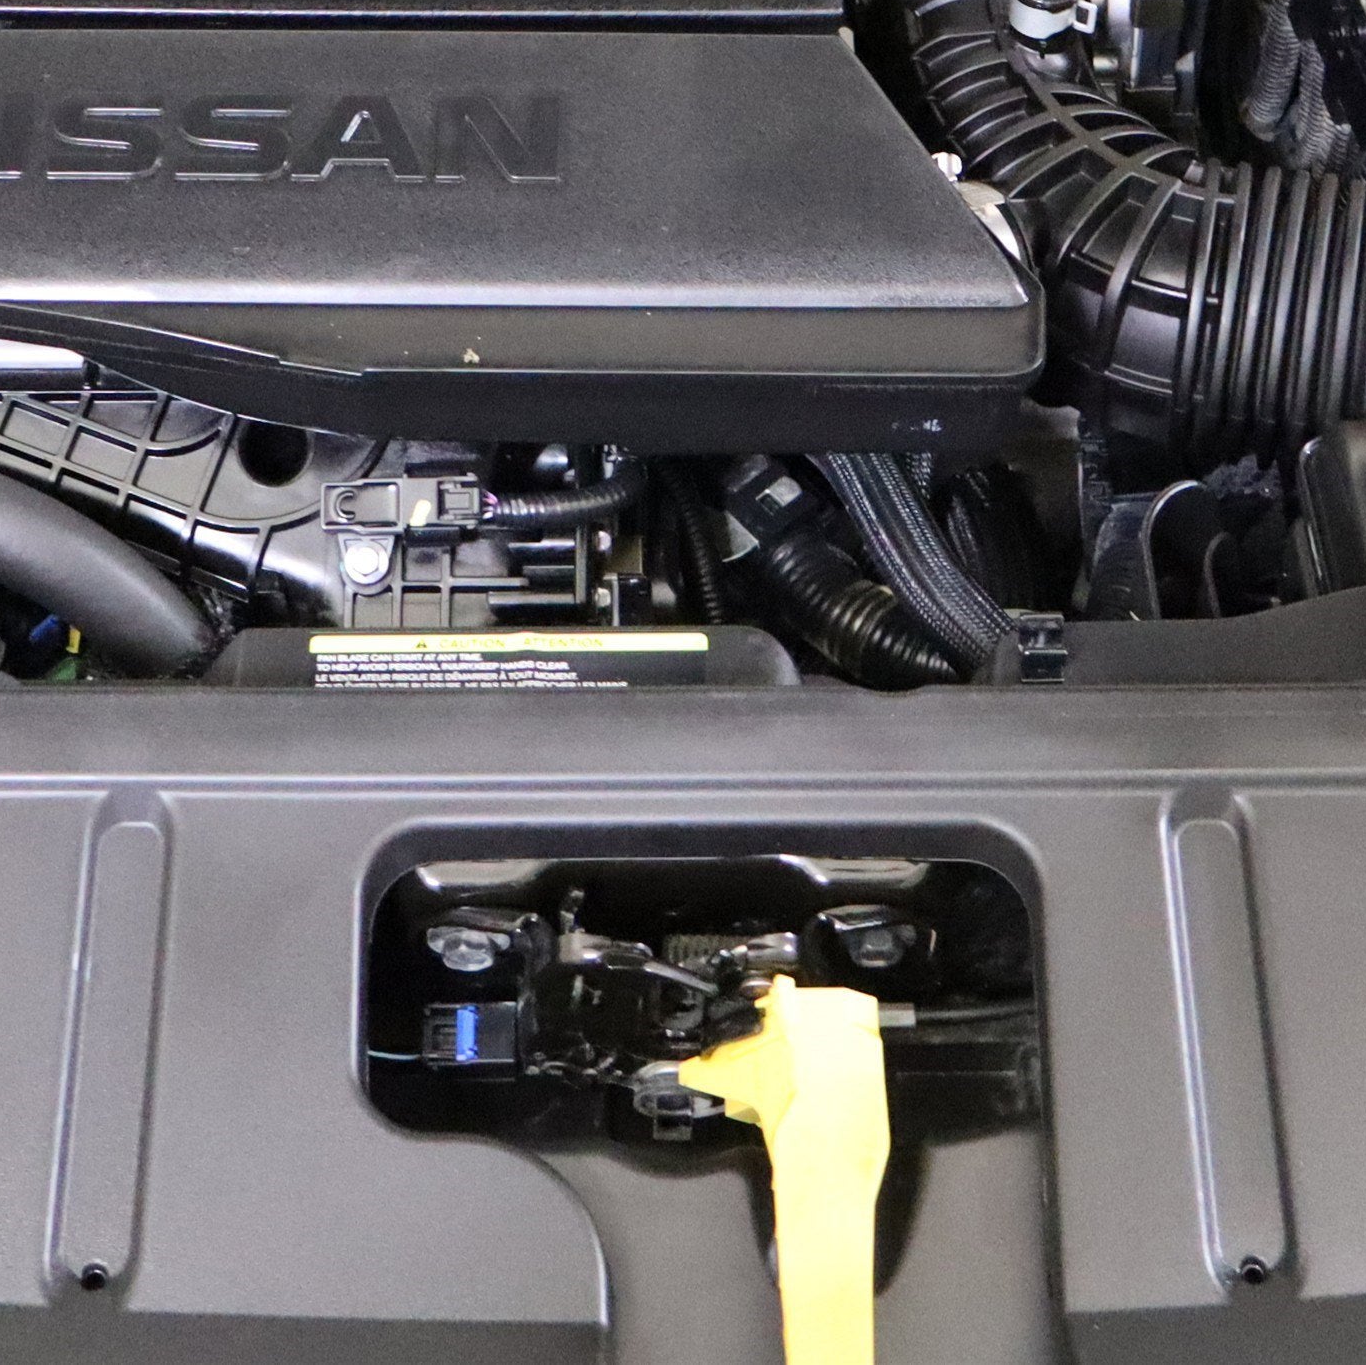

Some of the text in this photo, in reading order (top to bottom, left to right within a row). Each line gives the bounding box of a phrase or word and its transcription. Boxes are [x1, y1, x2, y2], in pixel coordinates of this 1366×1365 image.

[439, 637, 603, 649] CAUTION ATTENTION
[317, 653, 337, 662] FAN
[338, 653, 370, 662] BLADE
[370, 653, 392, 662] CAN
[393, 653, 423, 662] START
[423, 653, 436, 662] AT
[436, 653, 458, 662] ANY
[316, 663, 331, 672] TO
[331, 663, 357, 672] HELP
[358, 663, 388, 671] AVOID
[388, 662, 440, 671] PERSONAL
[500, 660, 535, 670] HANDS
[315, 673, 328, 682] LE
[328, 673, 391, 682] VENTILATEUR
[391, 673, 428, 682] RISQUE
[428, 673, 443, 681] DE
[508, 671, 534, 681] TOUT
